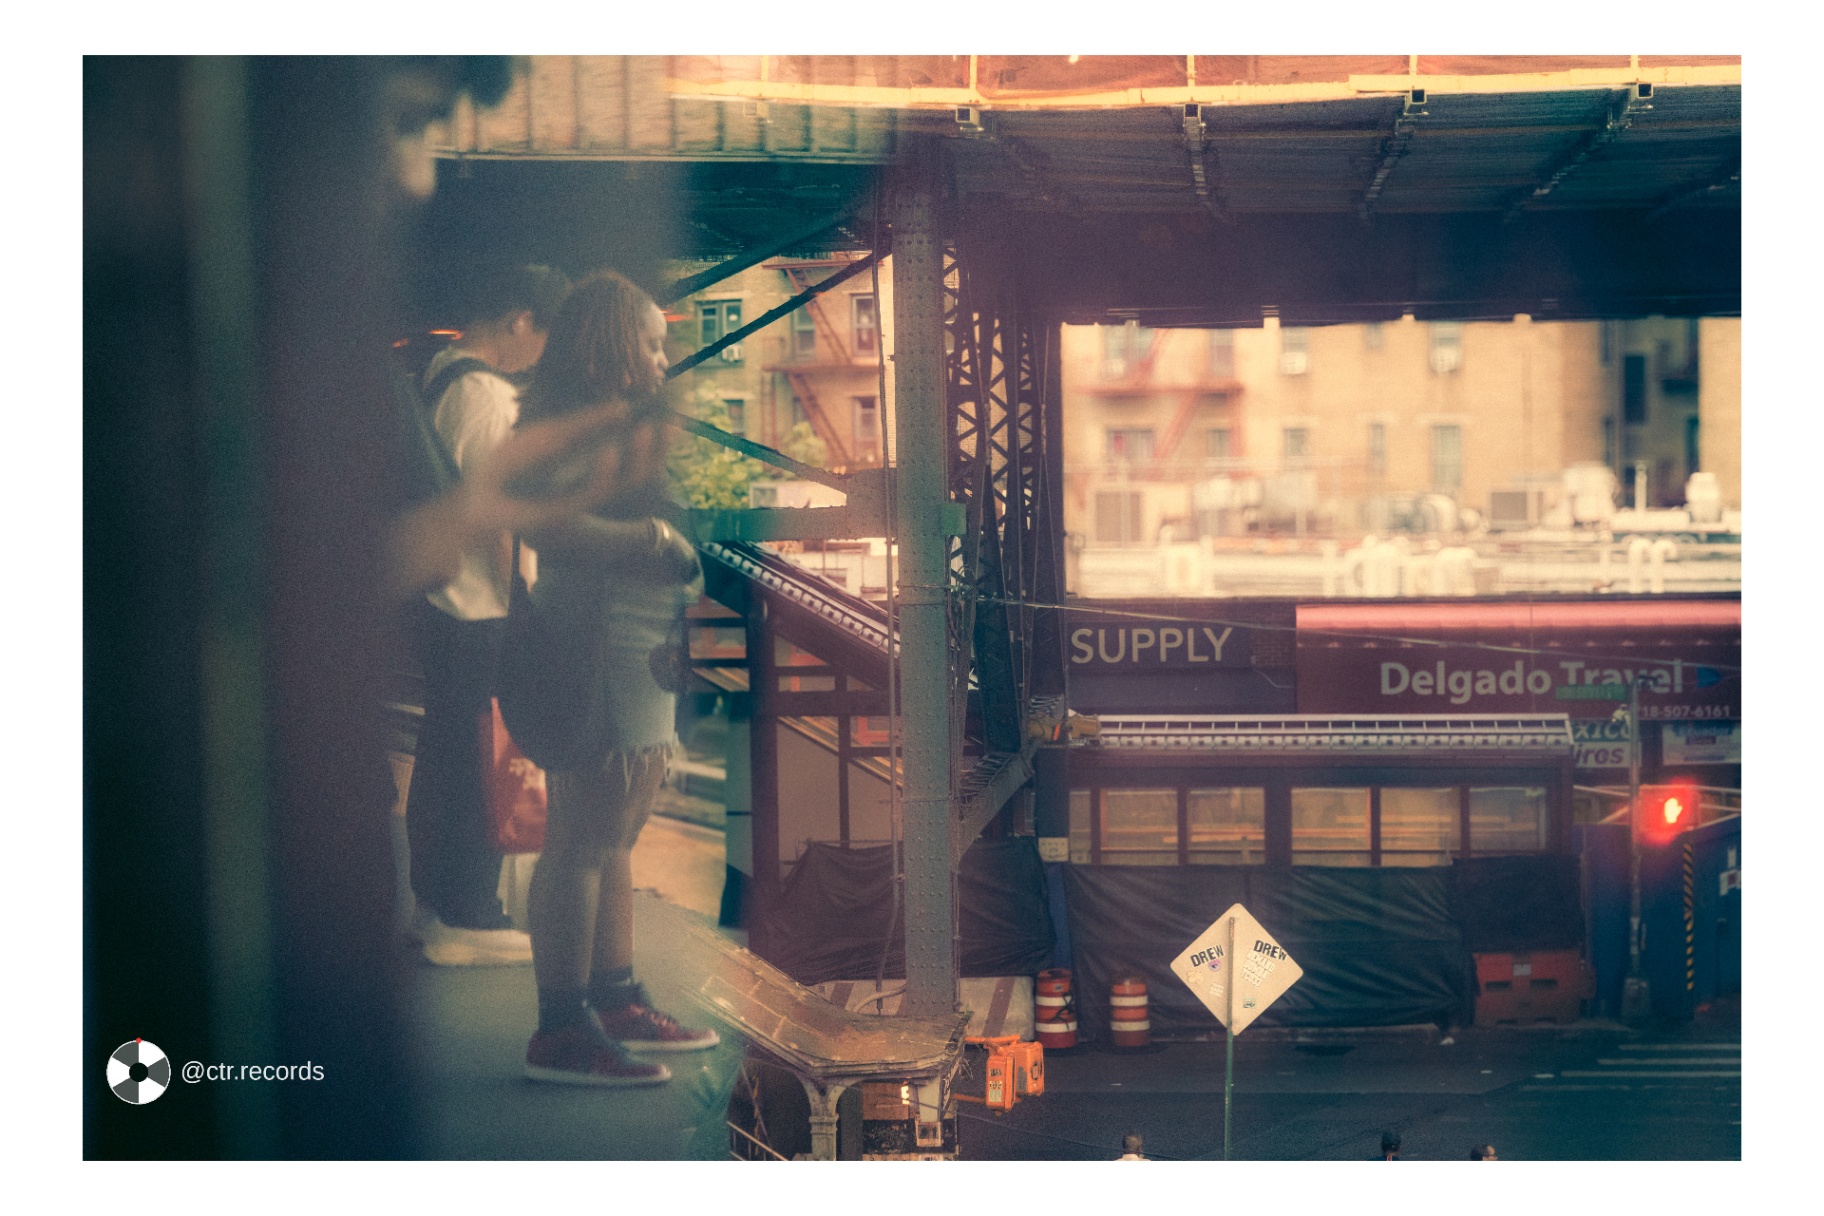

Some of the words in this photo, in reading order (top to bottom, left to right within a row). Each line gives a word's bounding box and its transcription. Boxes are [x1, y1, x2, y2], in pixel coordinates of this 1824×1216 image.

[1071, 627, 1233, 664] SUPPLY
[1381, 660, 1551, 704] Delgado
[1559, 659, 1683, 696] Travel
[1638, 705, 1731, 719] 18-507-6161
[1574, 742, 1624, 764] iros
[1190, 945, 1224, 967] DREW
[1253, 940, 1287, 961] DREW
